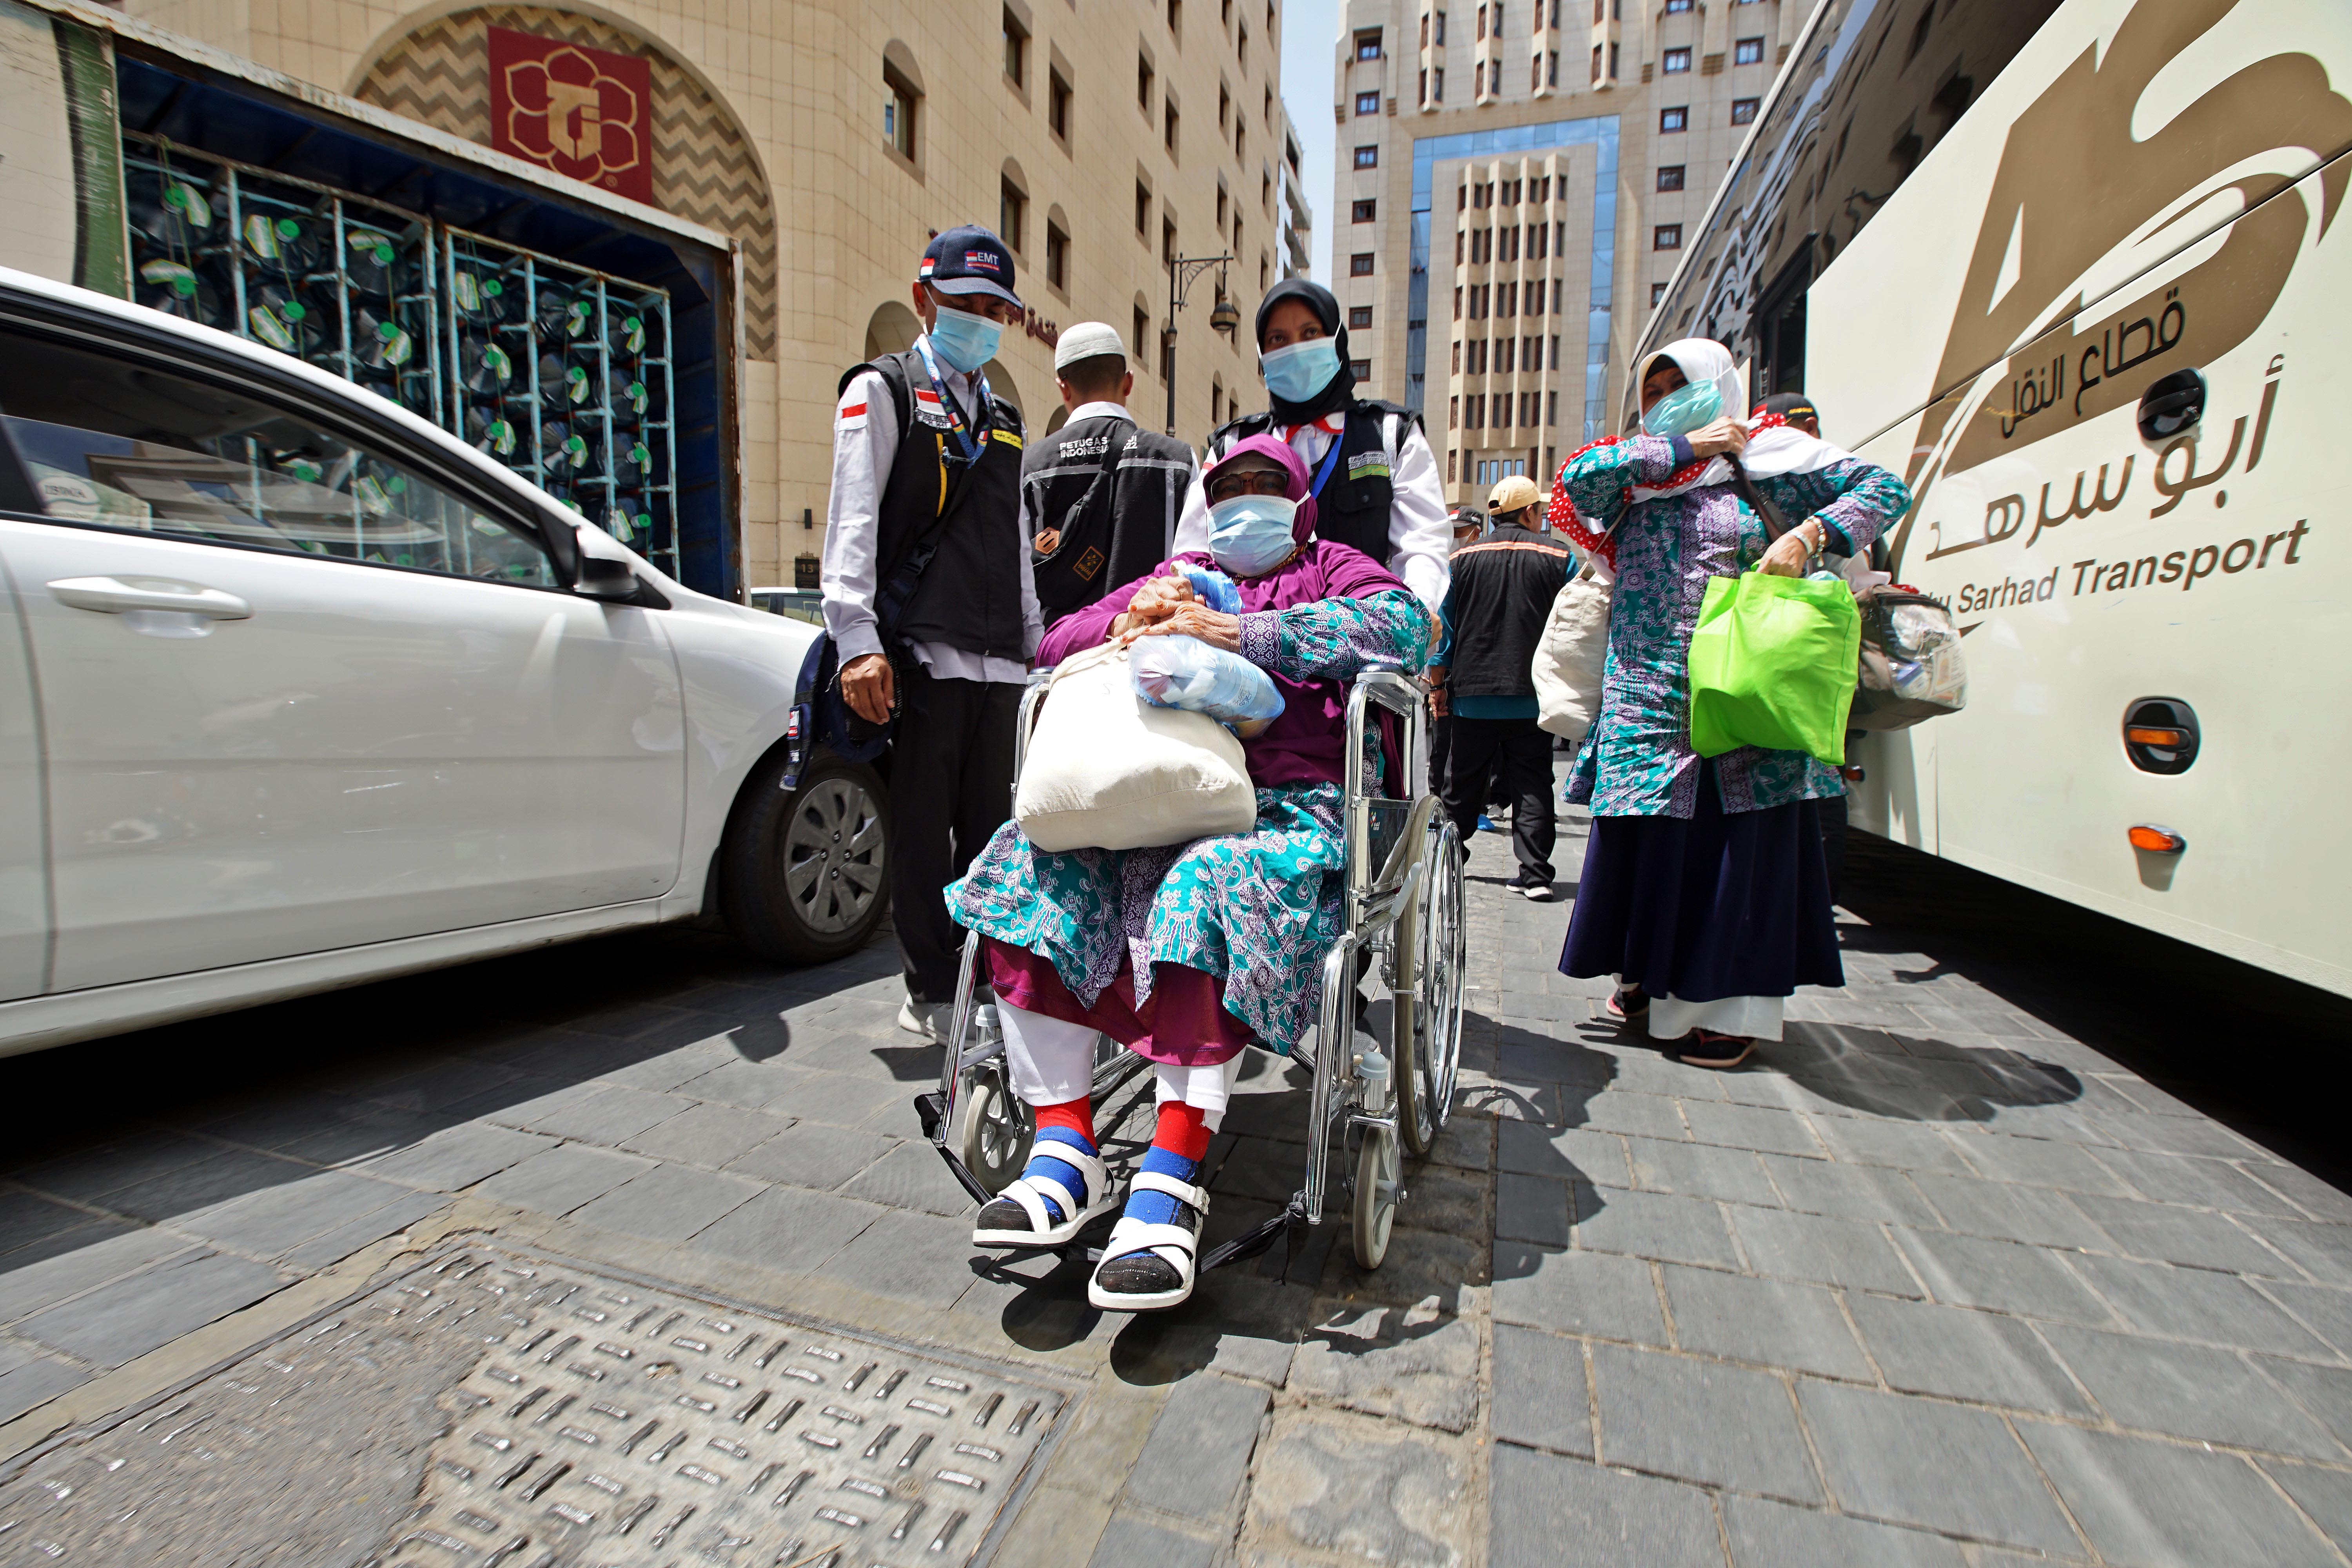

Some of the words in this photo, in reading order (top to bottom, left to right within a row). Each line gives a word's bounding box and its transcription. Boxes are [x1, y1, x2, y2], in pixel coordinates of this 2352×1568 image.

[978, 252, 998, 265] EMT
[2076, 286, 2186, 417] قطاع
[2002, 354, 2065, 439] النقل
[2150, 353, 2285, 520] أبو
[1059, 436, 1108, 450] PETUGAS
[801, 564, 814, 573] 13
[1957, 566, 2061, 614] Sarhad
[2072, 518, 2311, 596] Transport
